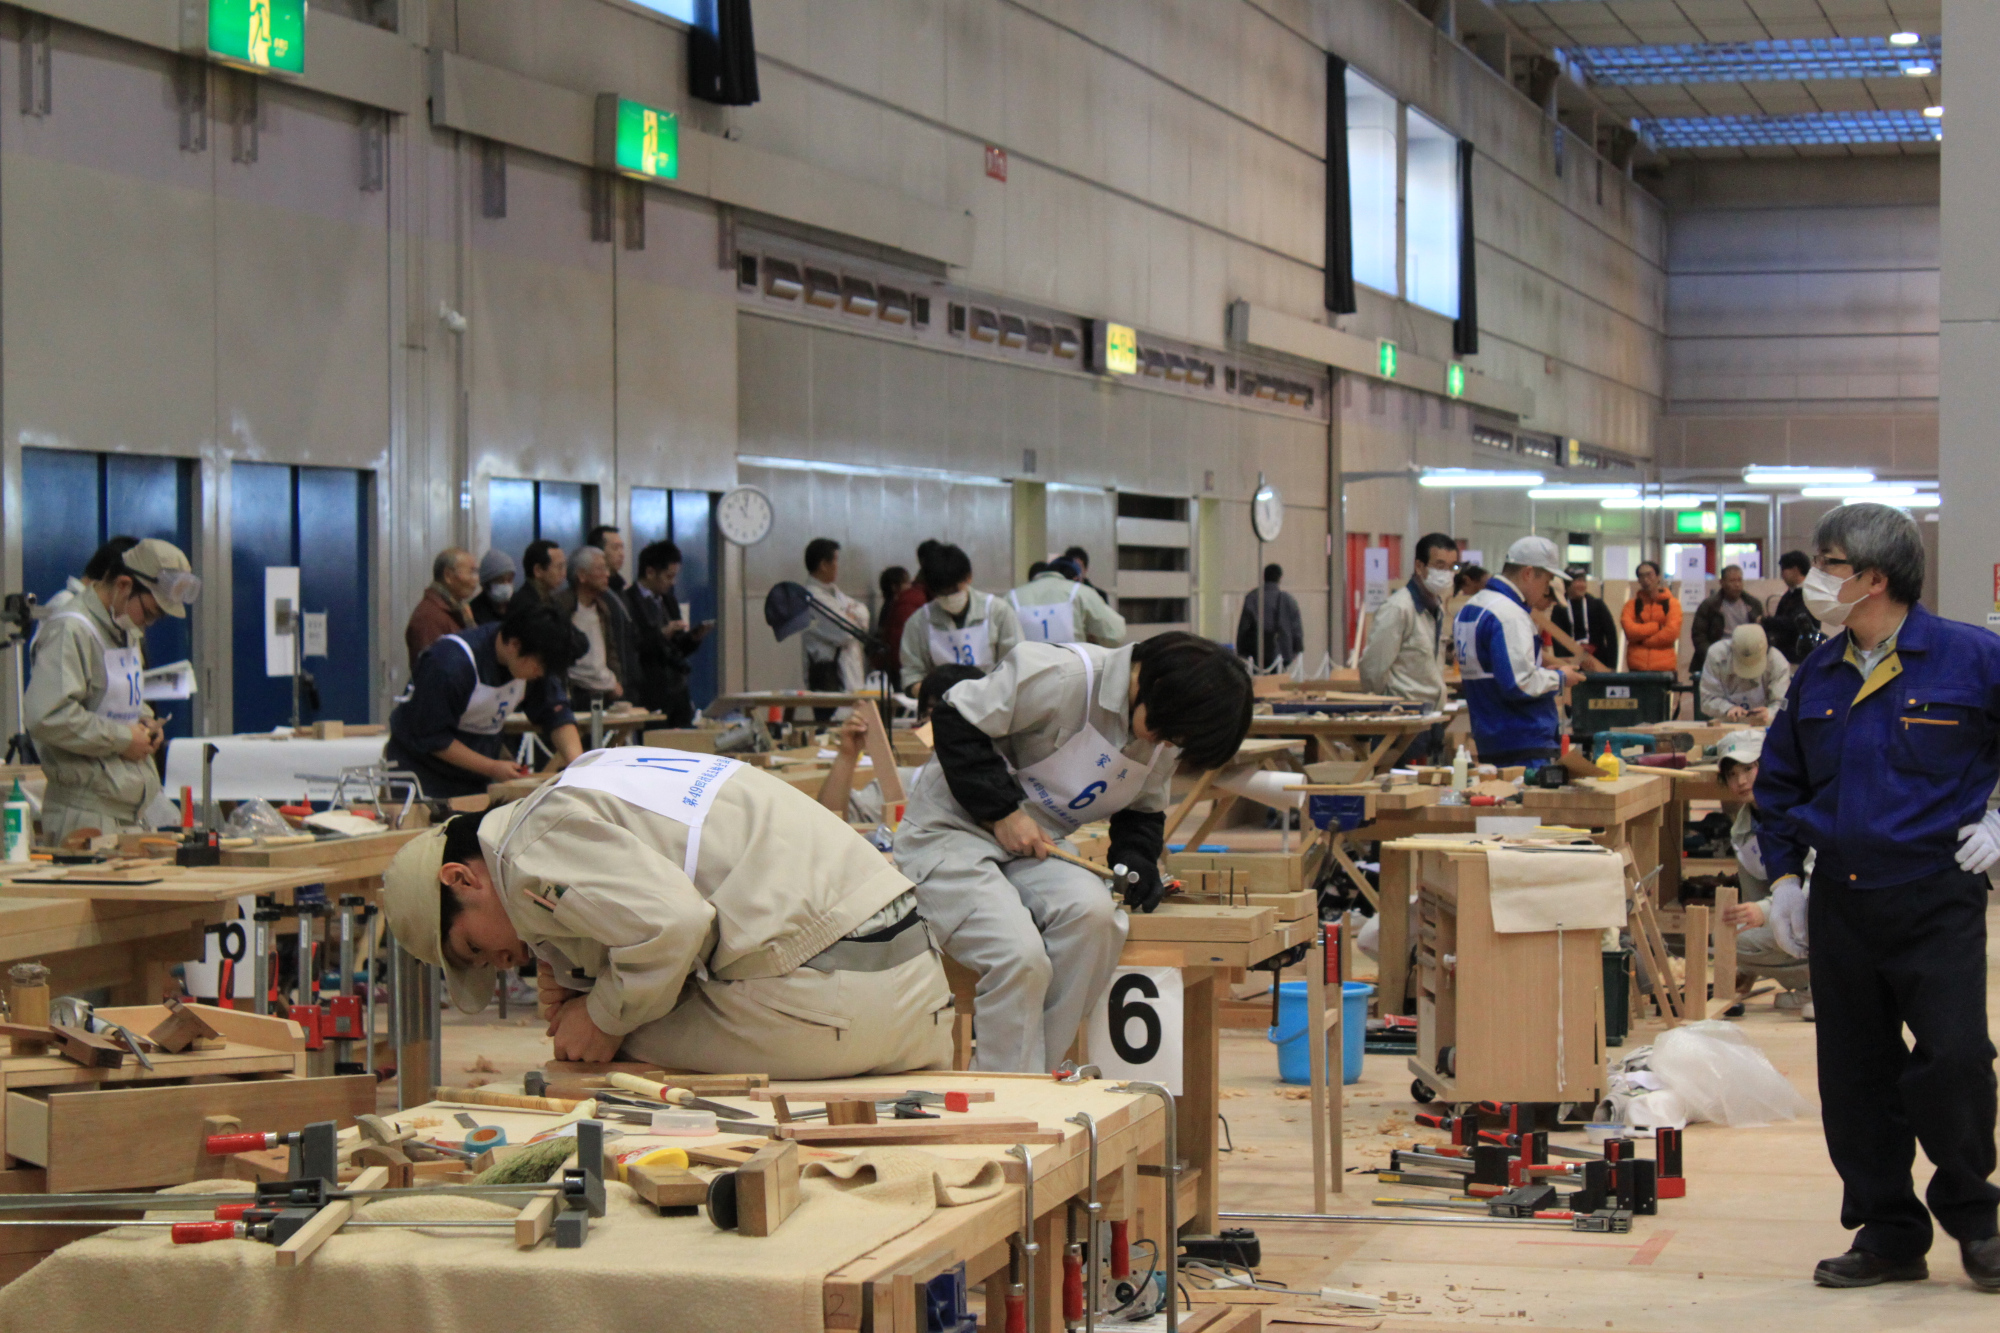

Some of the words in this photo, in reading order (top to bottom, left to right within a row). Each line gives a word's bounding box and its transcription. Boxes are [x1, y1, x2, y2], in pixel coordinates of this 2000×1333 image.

[1041, 619, 1048, 639] 1
[952, 644, 975, 665] 13
[1068, 780, 1107, 810] 6
[1108, 973, 1162, 1064] 6
